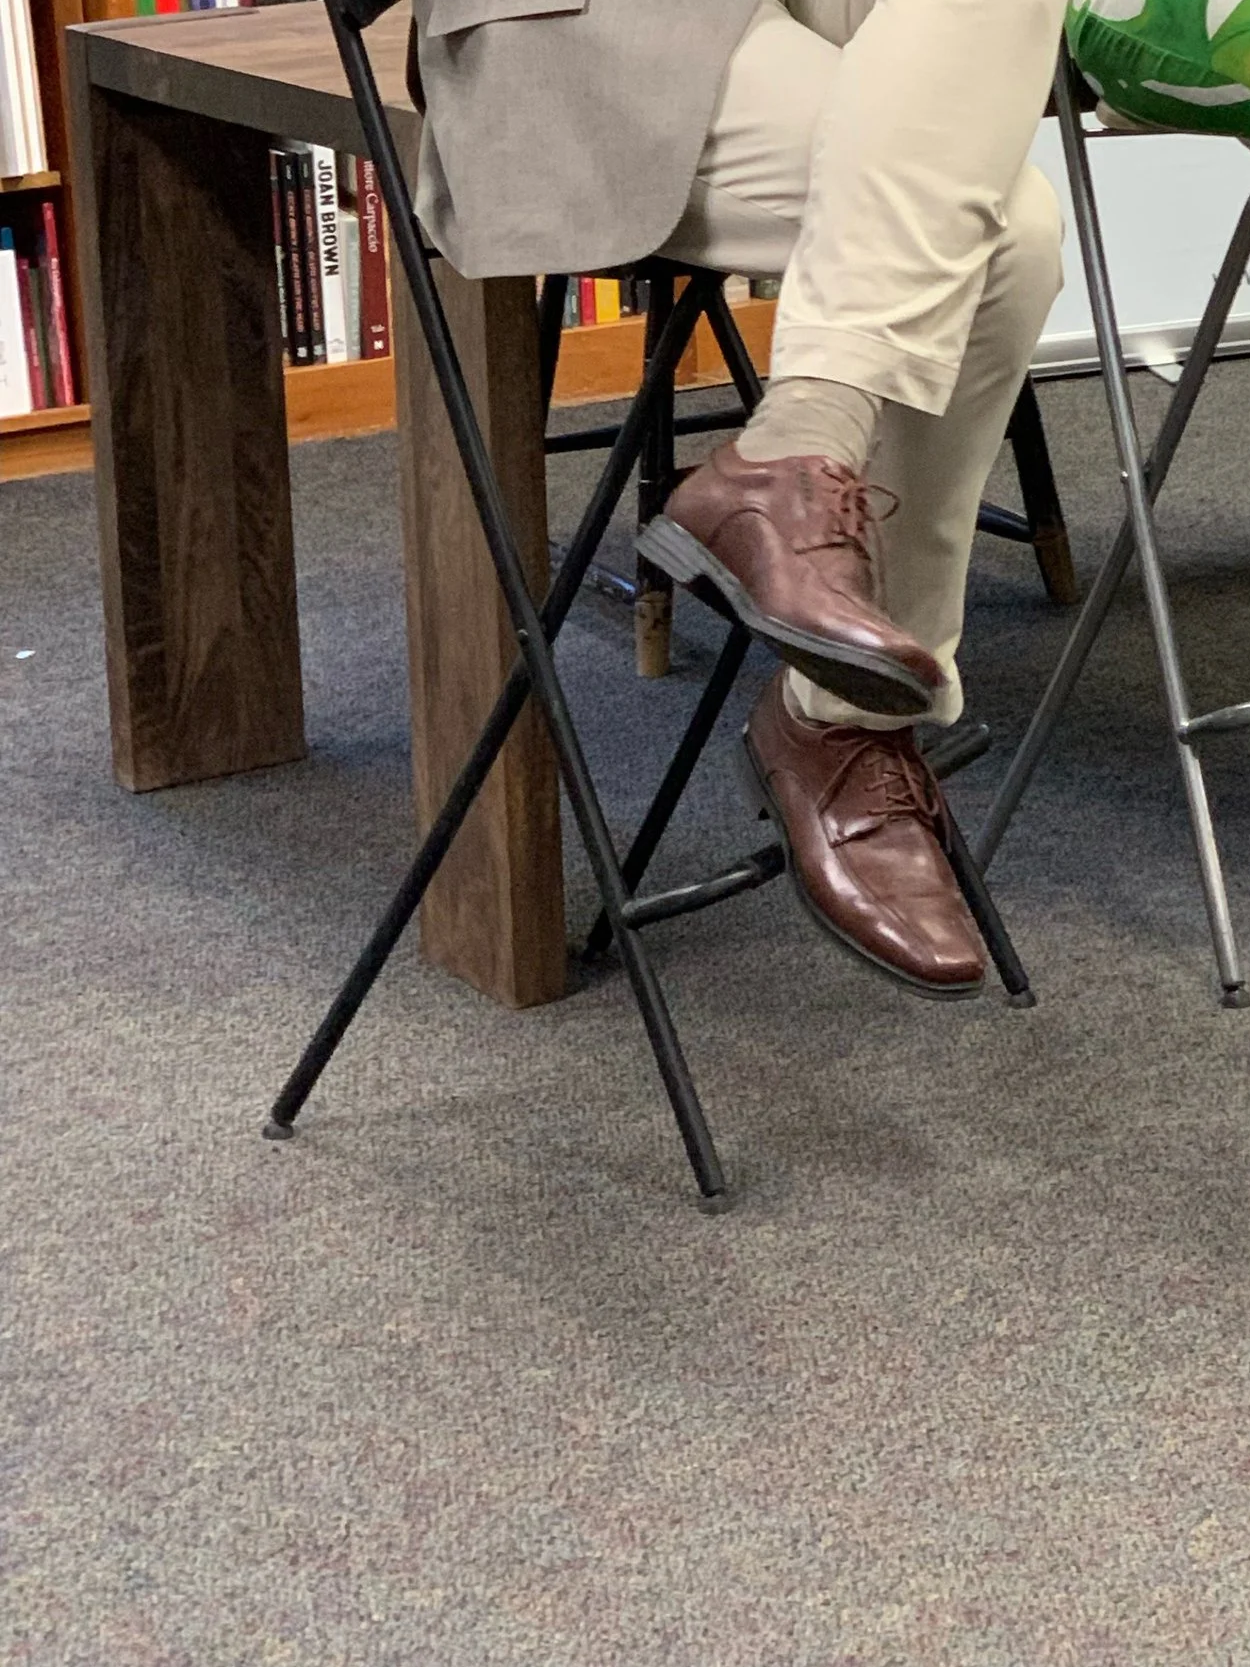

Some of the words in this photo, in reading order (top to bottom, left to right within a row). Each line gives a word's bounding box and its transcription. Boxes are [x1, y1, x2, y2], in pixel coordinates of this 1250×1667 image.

[318, 159, 335, 206] JOAN
[321, 211, 340, 277] BROWN
[362, 192, 381, 254] Carpaccio
